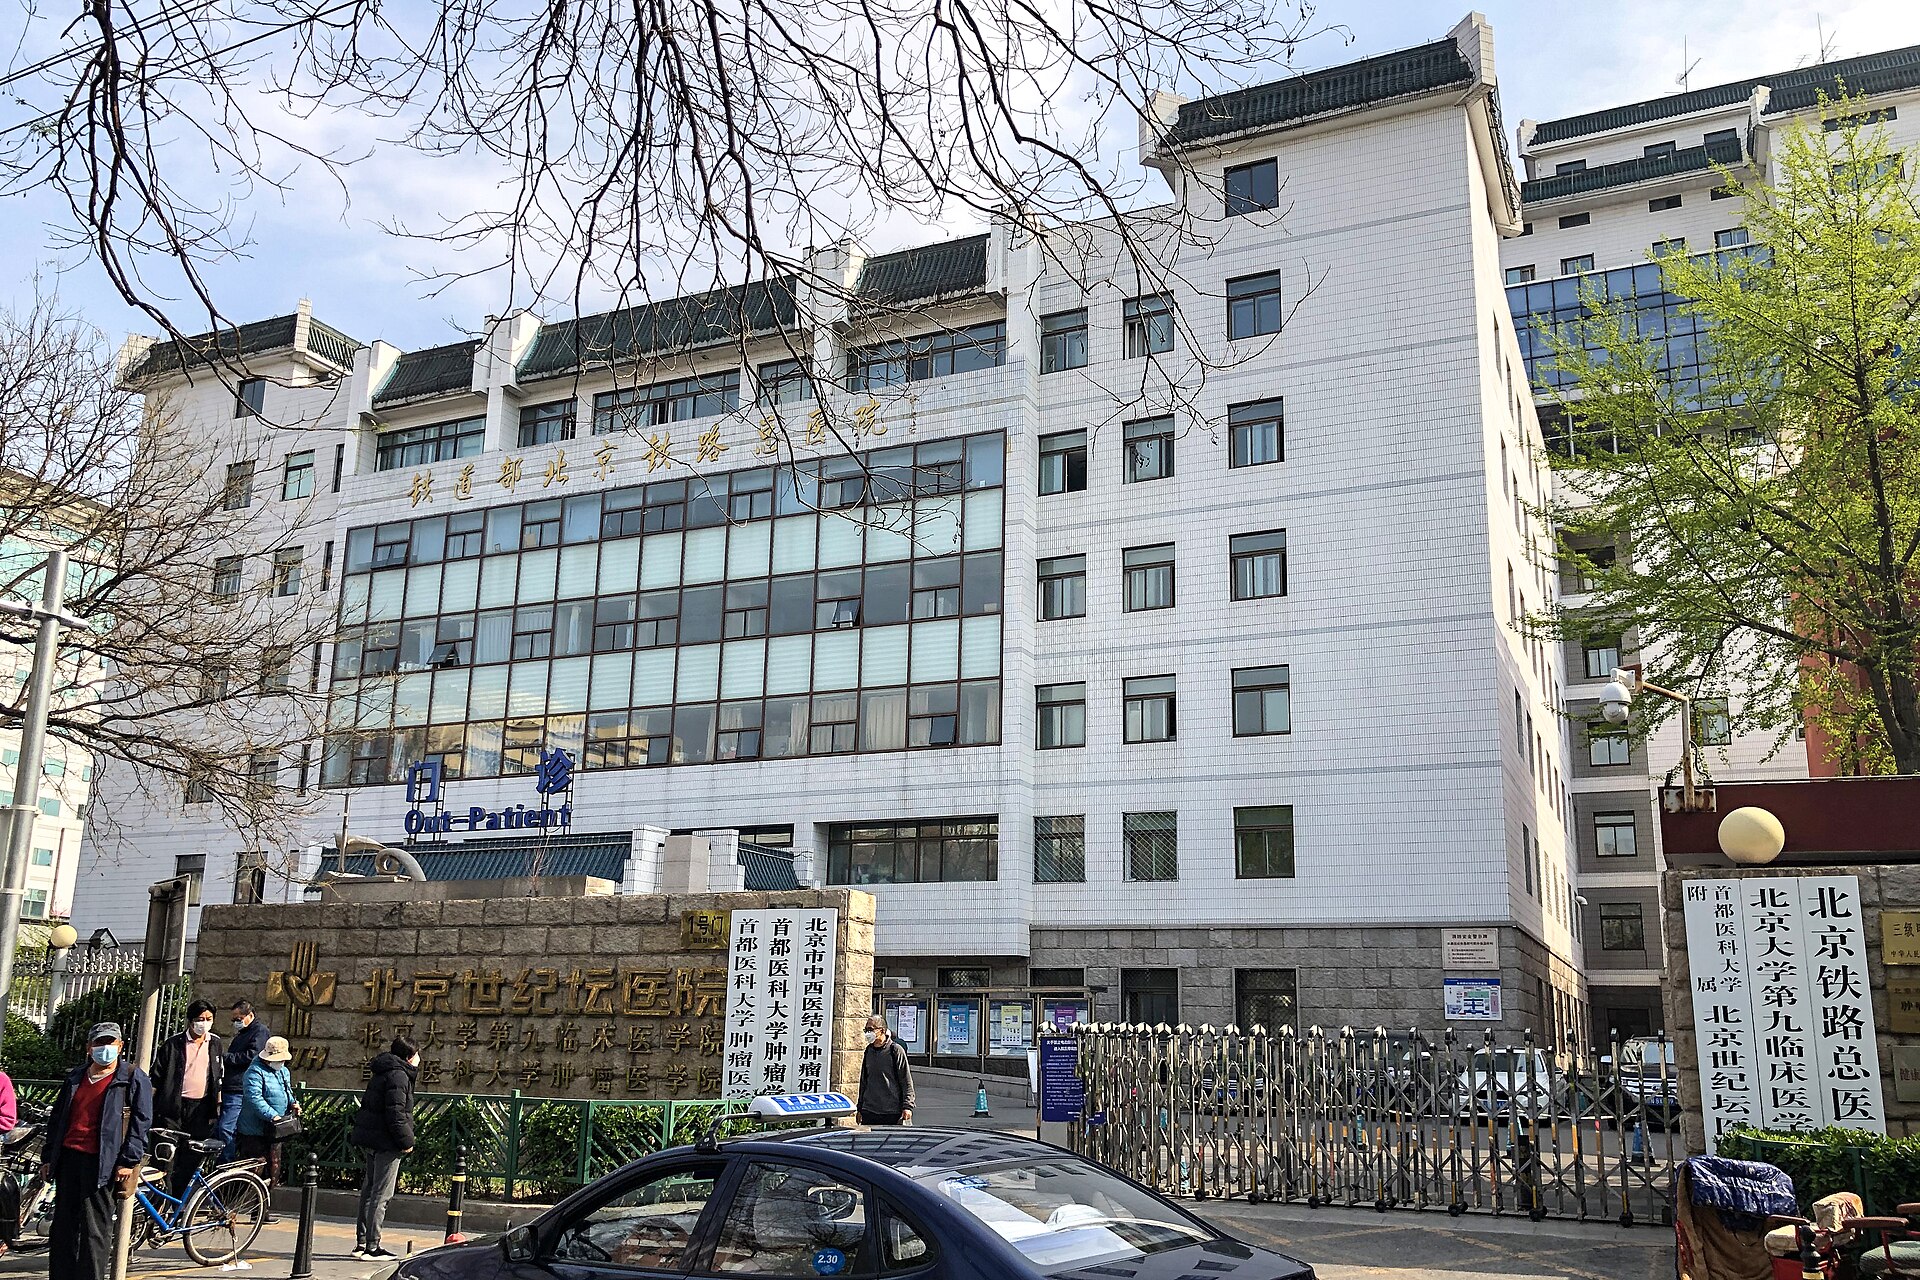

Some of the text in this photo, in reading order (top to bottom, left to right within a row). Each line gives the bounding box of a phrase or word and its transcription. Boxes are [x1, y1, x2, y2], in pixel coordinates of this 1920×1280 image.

[406, 747, 575, 802] 门诊
[405, 804, 572, 834] Out-Patient
[688, 915, 724, 935] 1号门
[361, 967, 727, 1016] 北京世纪坛医院
[1807, 887, 1878, 1134] 北京铁路总医
[360, 1056, 722, 1092] 首医科大学肿瘤医学院
[774, 1093, 844, 1106] TAXI
[817, 1254, 838, 1264] 2.30
